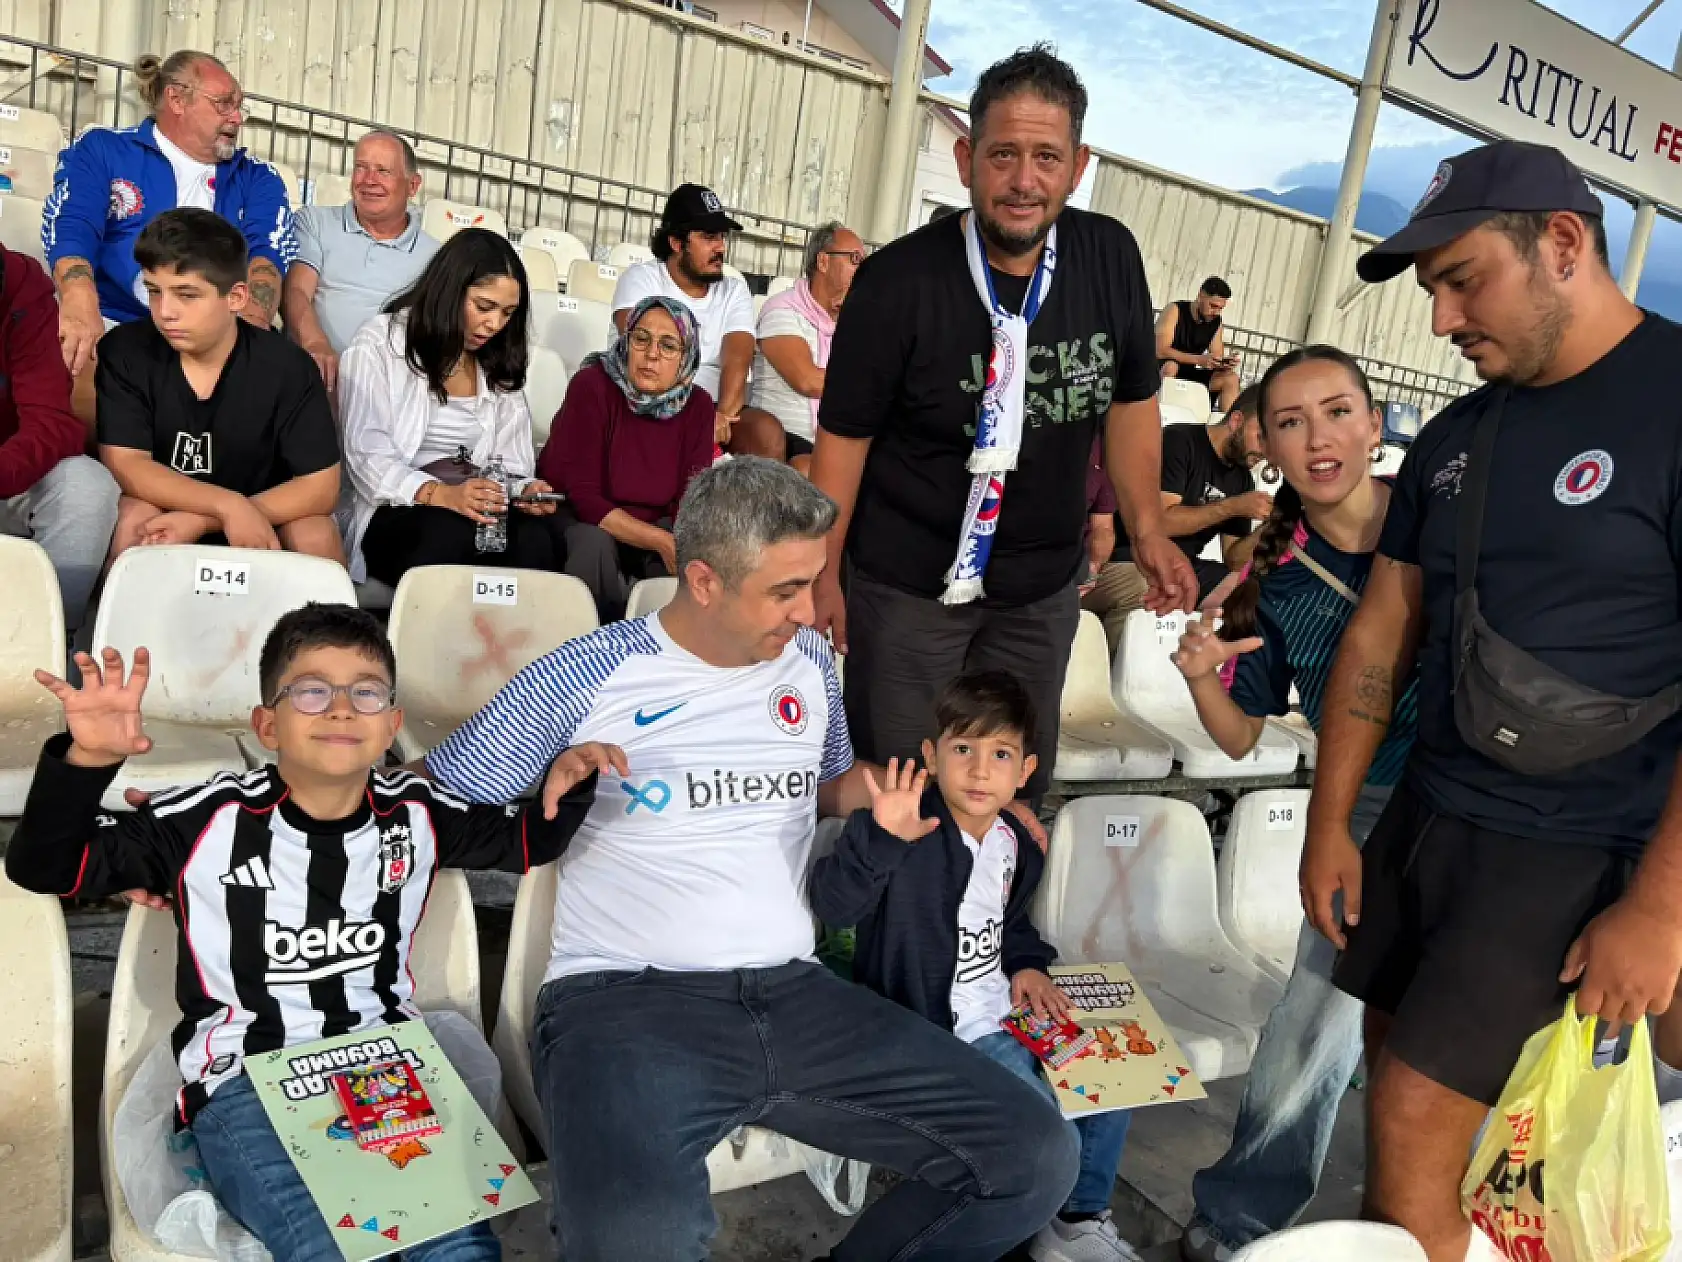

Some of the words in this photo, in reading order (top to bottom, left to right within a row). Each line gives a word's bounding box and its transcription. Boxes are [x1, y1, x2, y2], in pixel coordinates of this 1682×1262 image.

[1498, 44, 1639, 162] RITUAL
[201, 567, 247, 586] D-14
[477, 582, 515, 597] D-15
[1156, 620, 1177, 631] D-19
[685, 769, 818, 809] bitexen
[1106, 823, 1138, 838] D-17
[1269, 809, 1293, 823] D-18
[263, 918, 387, 963] beko
[957, 918, 1004, 962] bek
[287, 1036, 399, 1076] BOYAMA
